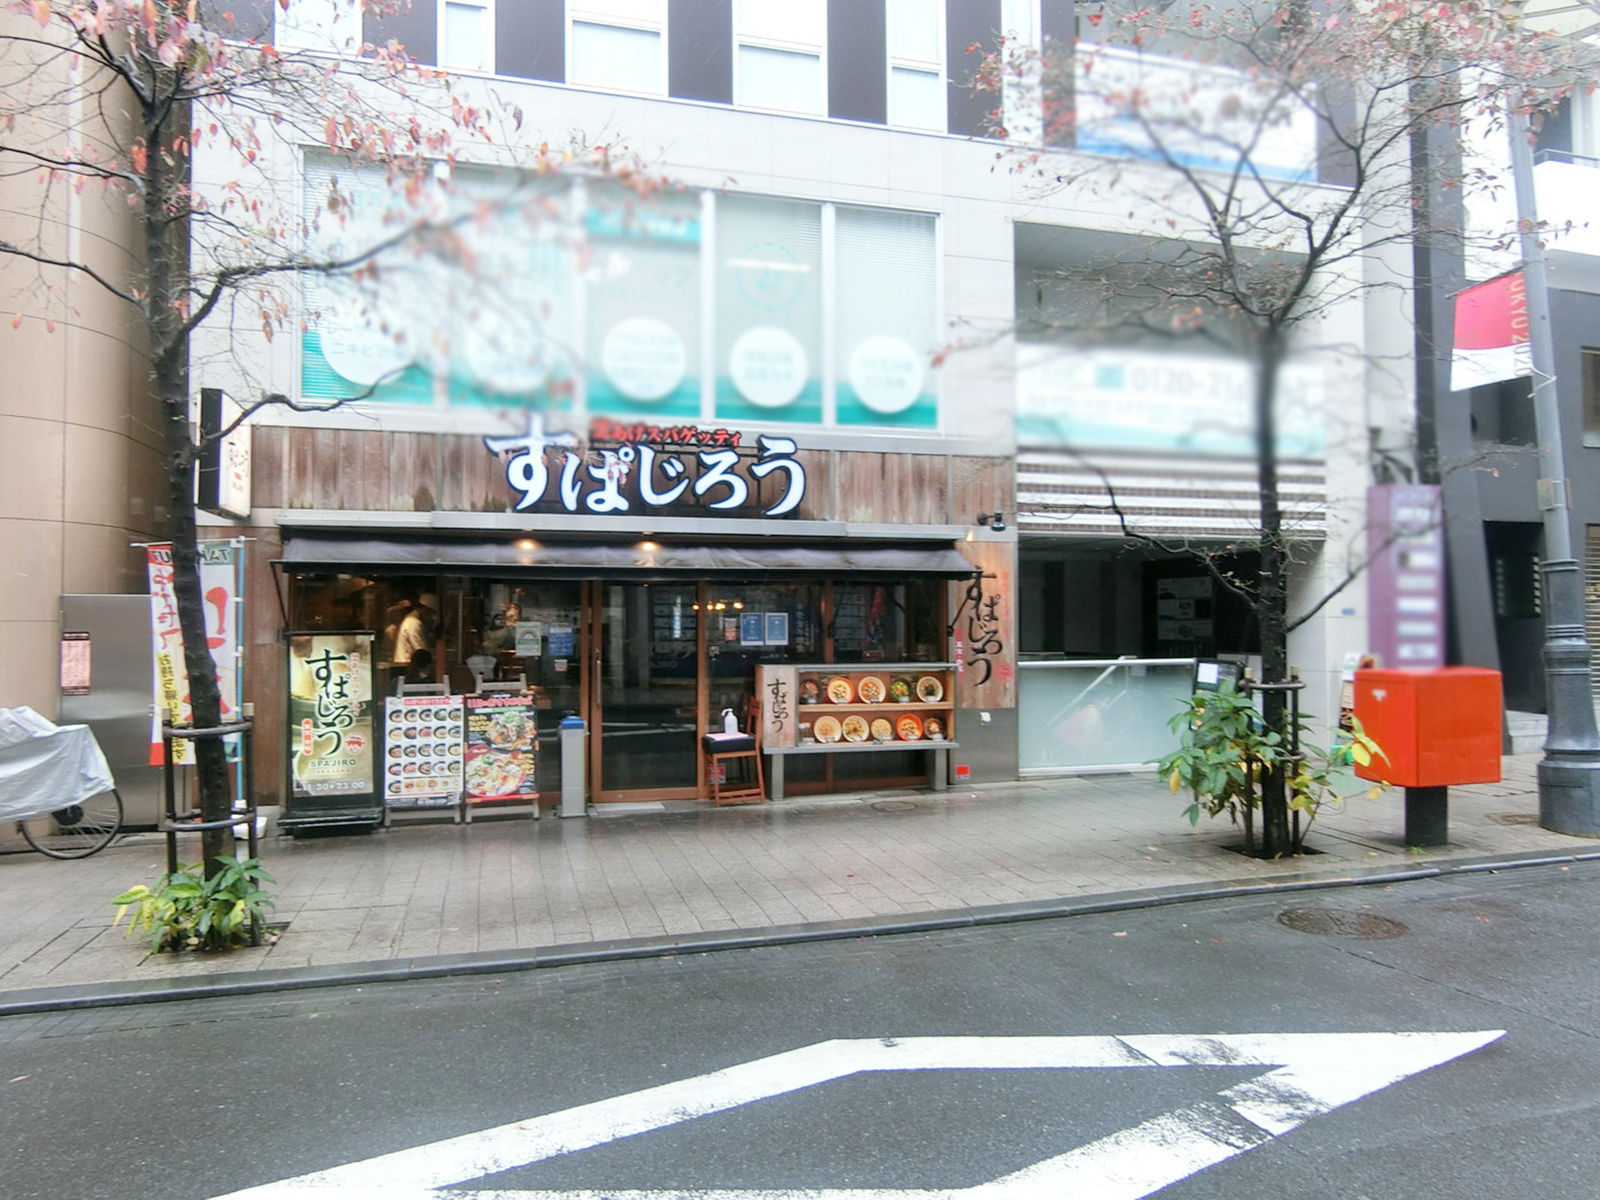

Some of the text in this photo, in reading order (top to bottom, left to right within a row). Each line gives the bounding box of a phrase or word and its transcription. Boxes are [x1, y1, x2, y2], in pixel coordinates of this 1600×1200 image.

[1510, 270, 1534, 377] OKYO 2020
[483, 411, 806, 516] すぱじろう
[963, 564, 1003, 687] すぱじろう
[304, 648, 354, 756] すぱじろう
[766, 677, 789, 733] すぱじろう
[310, 758, 357, 768] SPAJIRO
